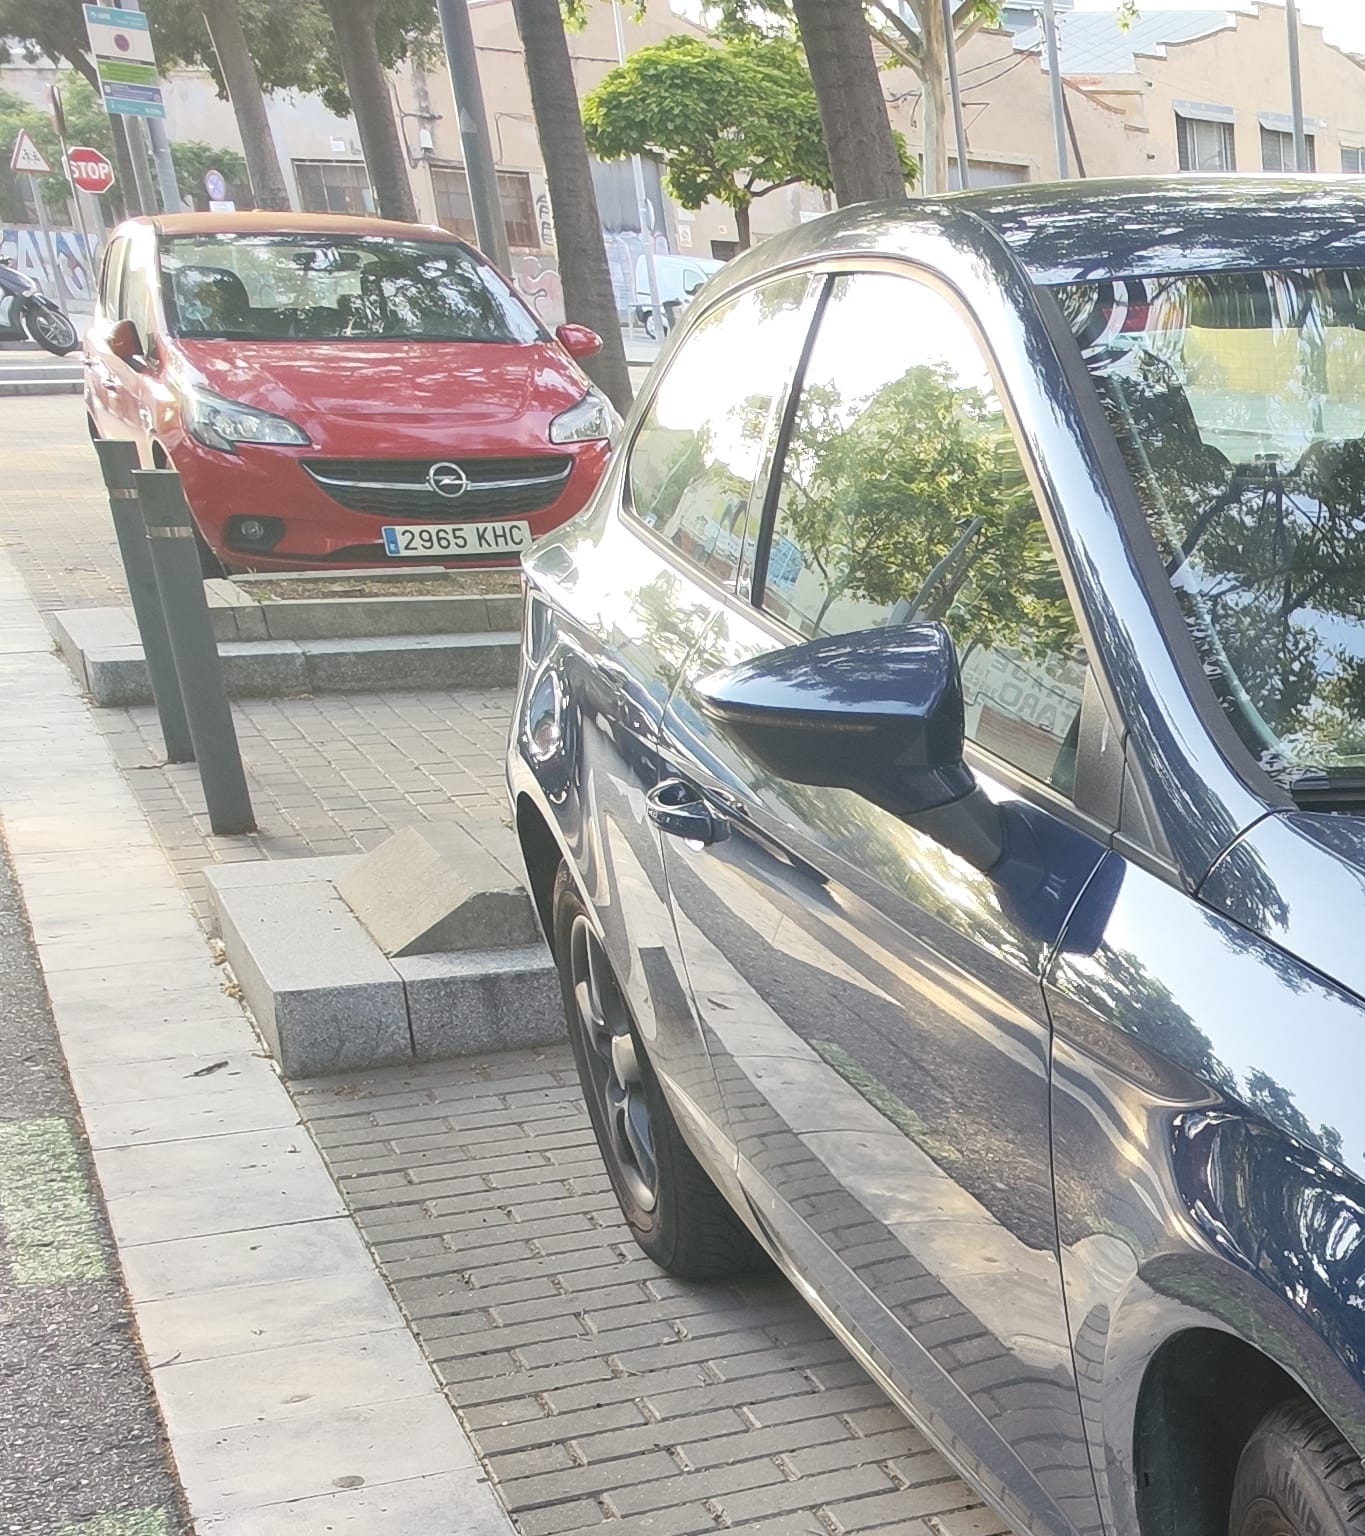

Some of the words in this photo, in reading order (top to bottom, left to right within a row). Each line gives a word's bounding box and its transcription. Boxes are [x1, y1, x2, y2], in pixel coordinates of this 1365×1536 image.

[70, 160, 109, 179] STOP
[401, 528, 468, 551] 2965
[476, 525, 523, 548] KHC
